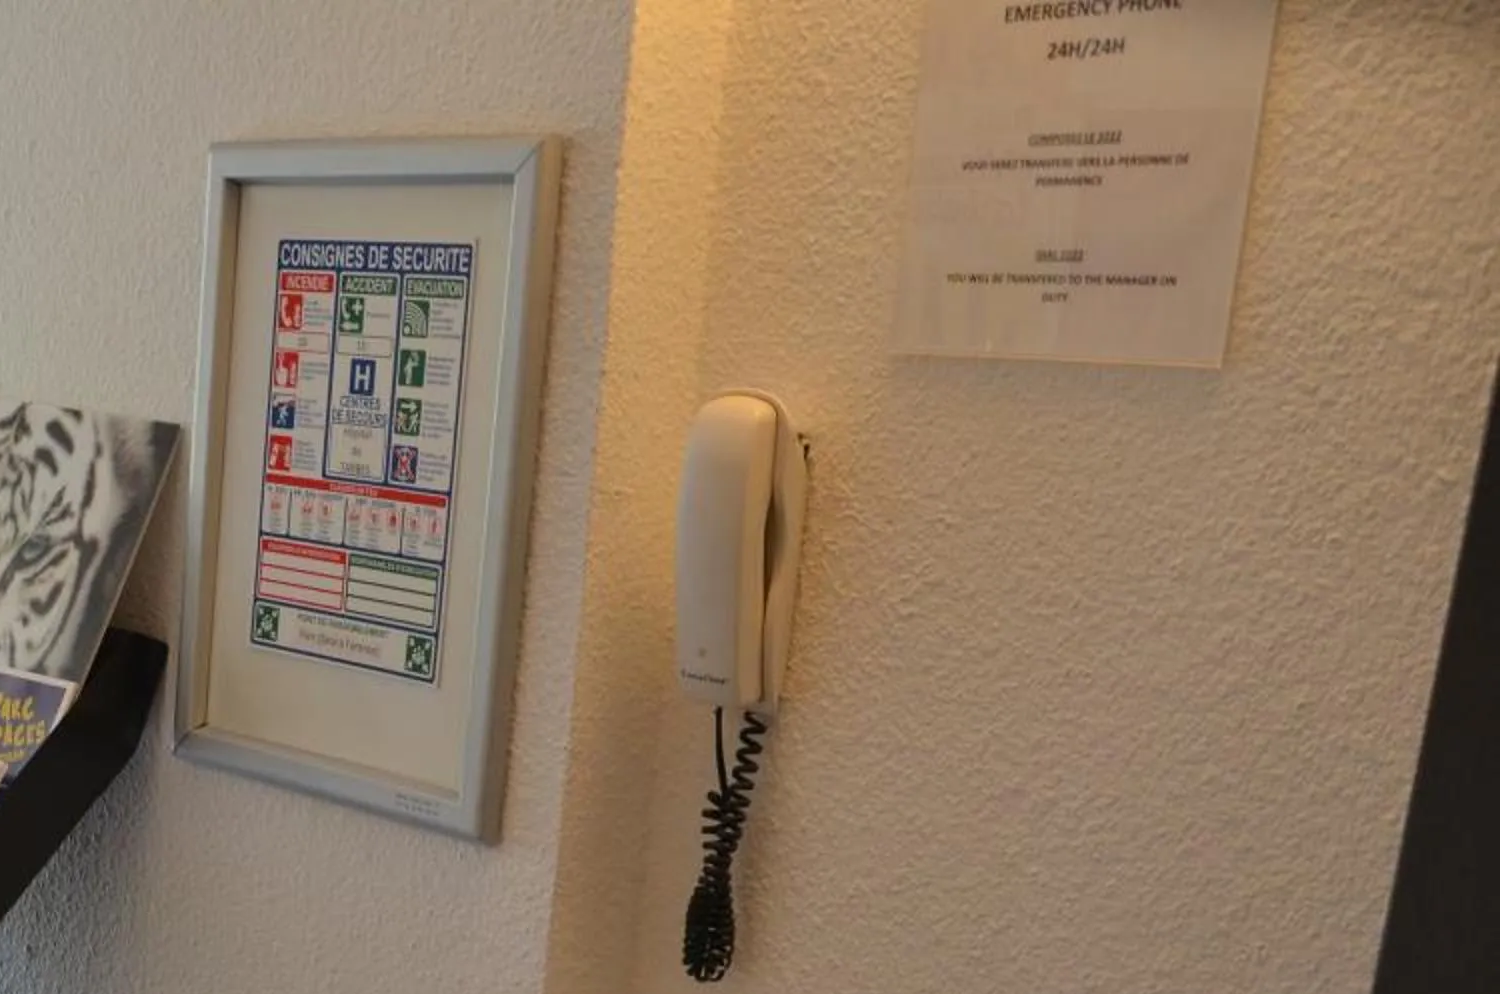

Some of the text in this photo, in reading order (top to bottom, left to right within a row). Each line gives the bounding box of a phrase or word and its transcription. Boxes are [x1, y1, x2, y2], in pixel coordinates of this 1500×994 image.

[1004, 0, 1112, 24] EMERGENCY
[1047, 36, 1126, 60] 24H/24H
[280, 243, 365, 268] CONSIGNES
[367, 245, 389, 269] DE
[344, 277, 393, 293] ACCIDENT
